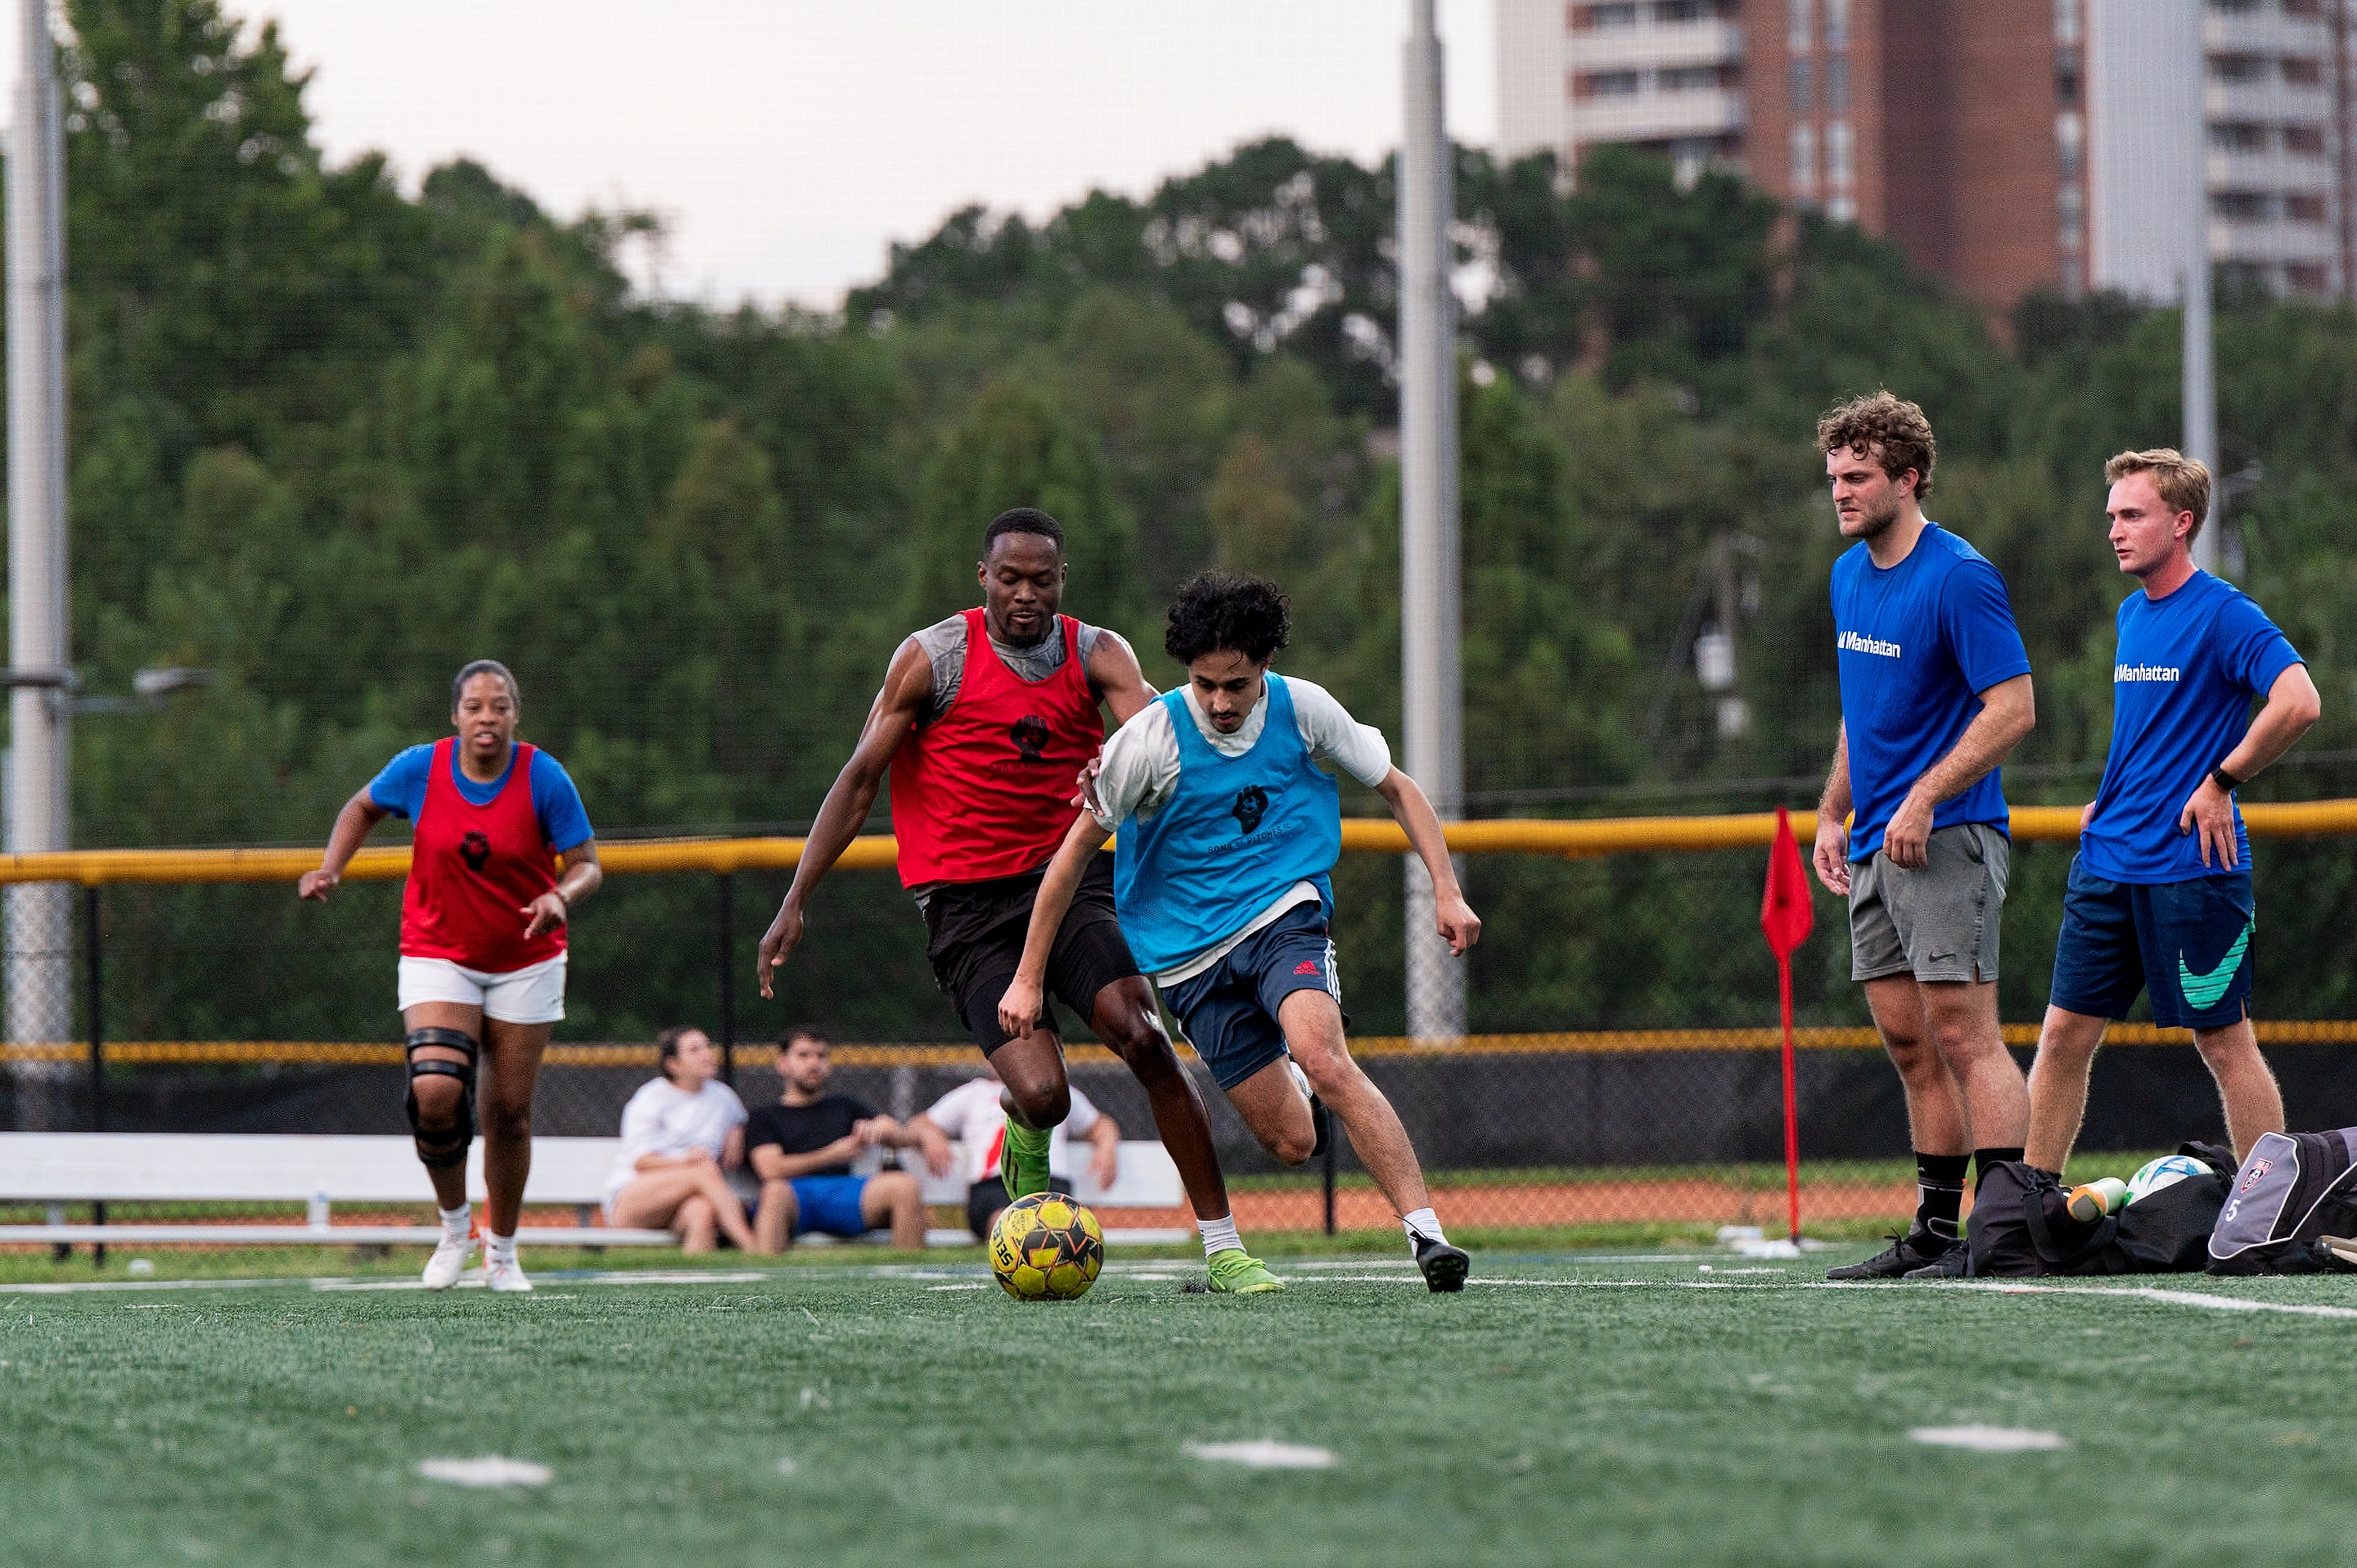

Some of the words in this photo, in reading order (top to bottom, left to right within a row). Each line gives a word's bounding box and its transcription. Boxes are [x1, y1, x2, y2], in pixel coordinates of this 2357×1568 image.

[1845, 631, 1901, 659] Manhattan
[2118, 663, 2179, 682] Manhattan
[1208, 843, 1233, 854] SONS
[1246, 827, 1282, 844] PITCHES
[2225, 1199, 2241, 1222] 5
[993, 1220, 1014, 1266] SEL
